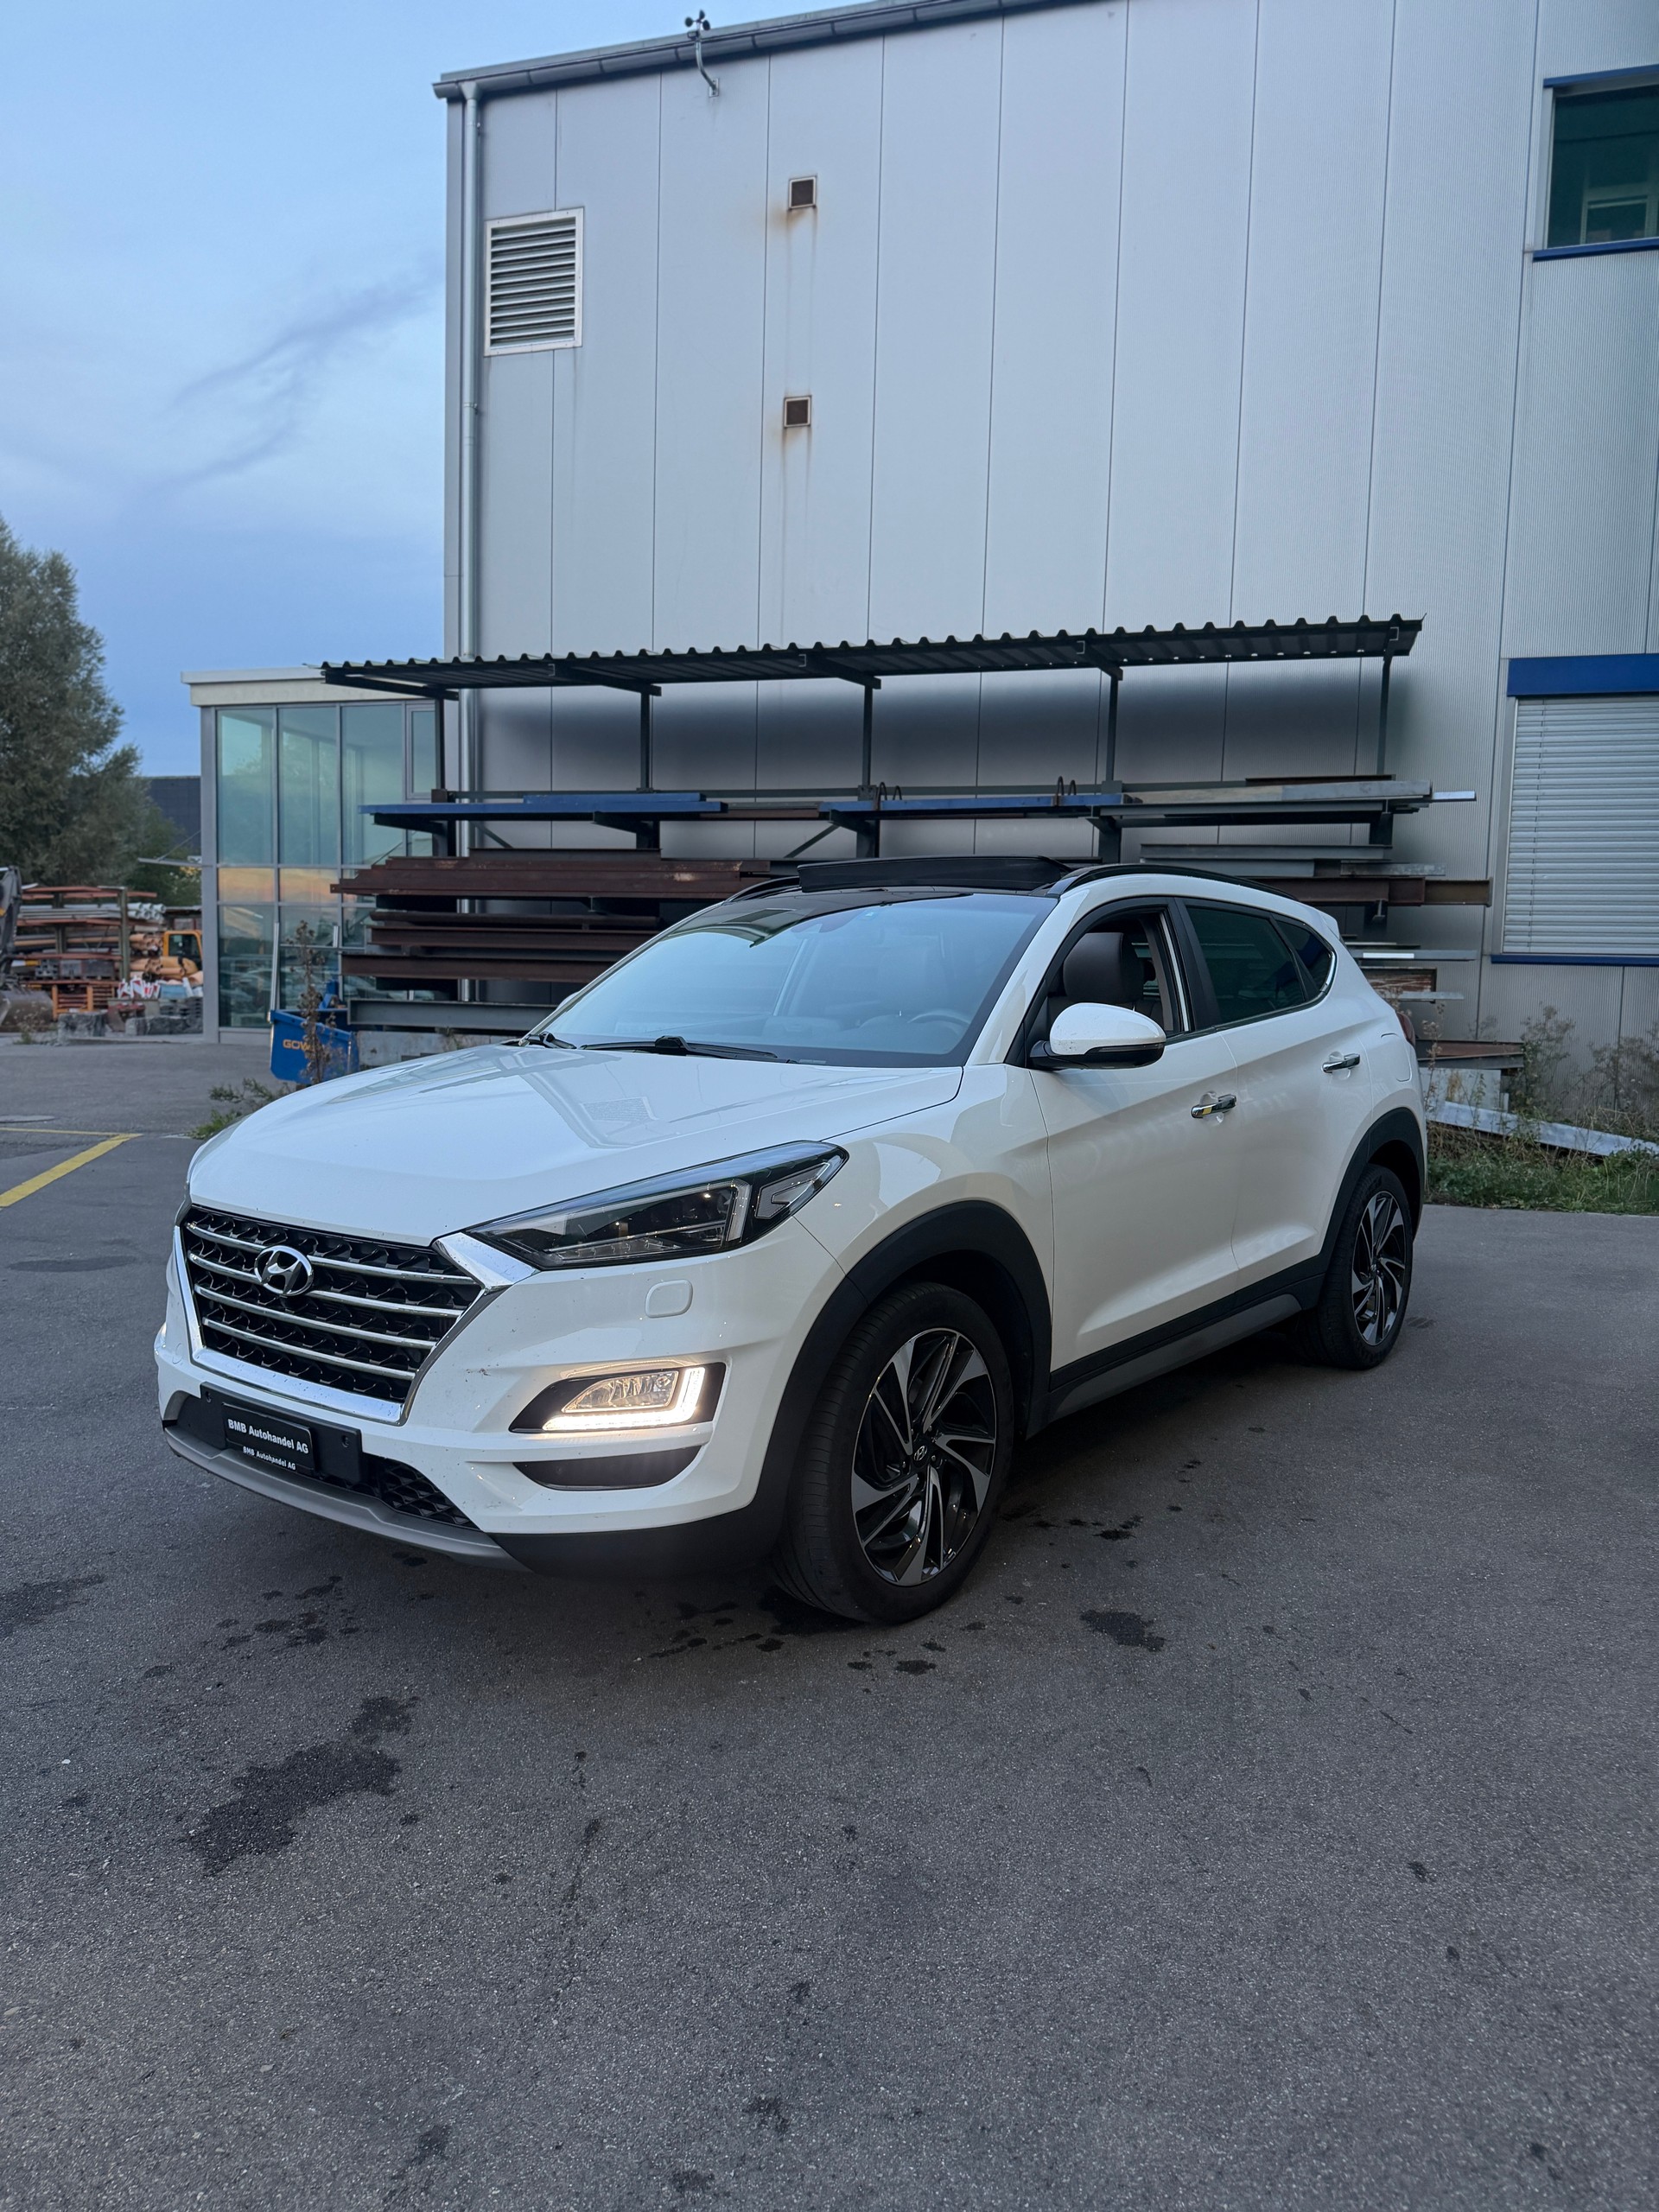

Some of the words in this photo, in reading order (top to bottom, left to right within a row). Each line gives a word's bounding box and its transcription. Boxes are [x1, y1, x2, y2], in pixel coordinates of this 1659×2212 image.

[227, 1419, 247, 1433] BMB
[249, 1426, 295, 1449] Autohandel
[296, 1441, 309, 1453] AG
[243, 1446, 255, 1456] BMB
[256, 1451, 287, 1467] Autohandel
[288, 1462, 296, 1471] AG
